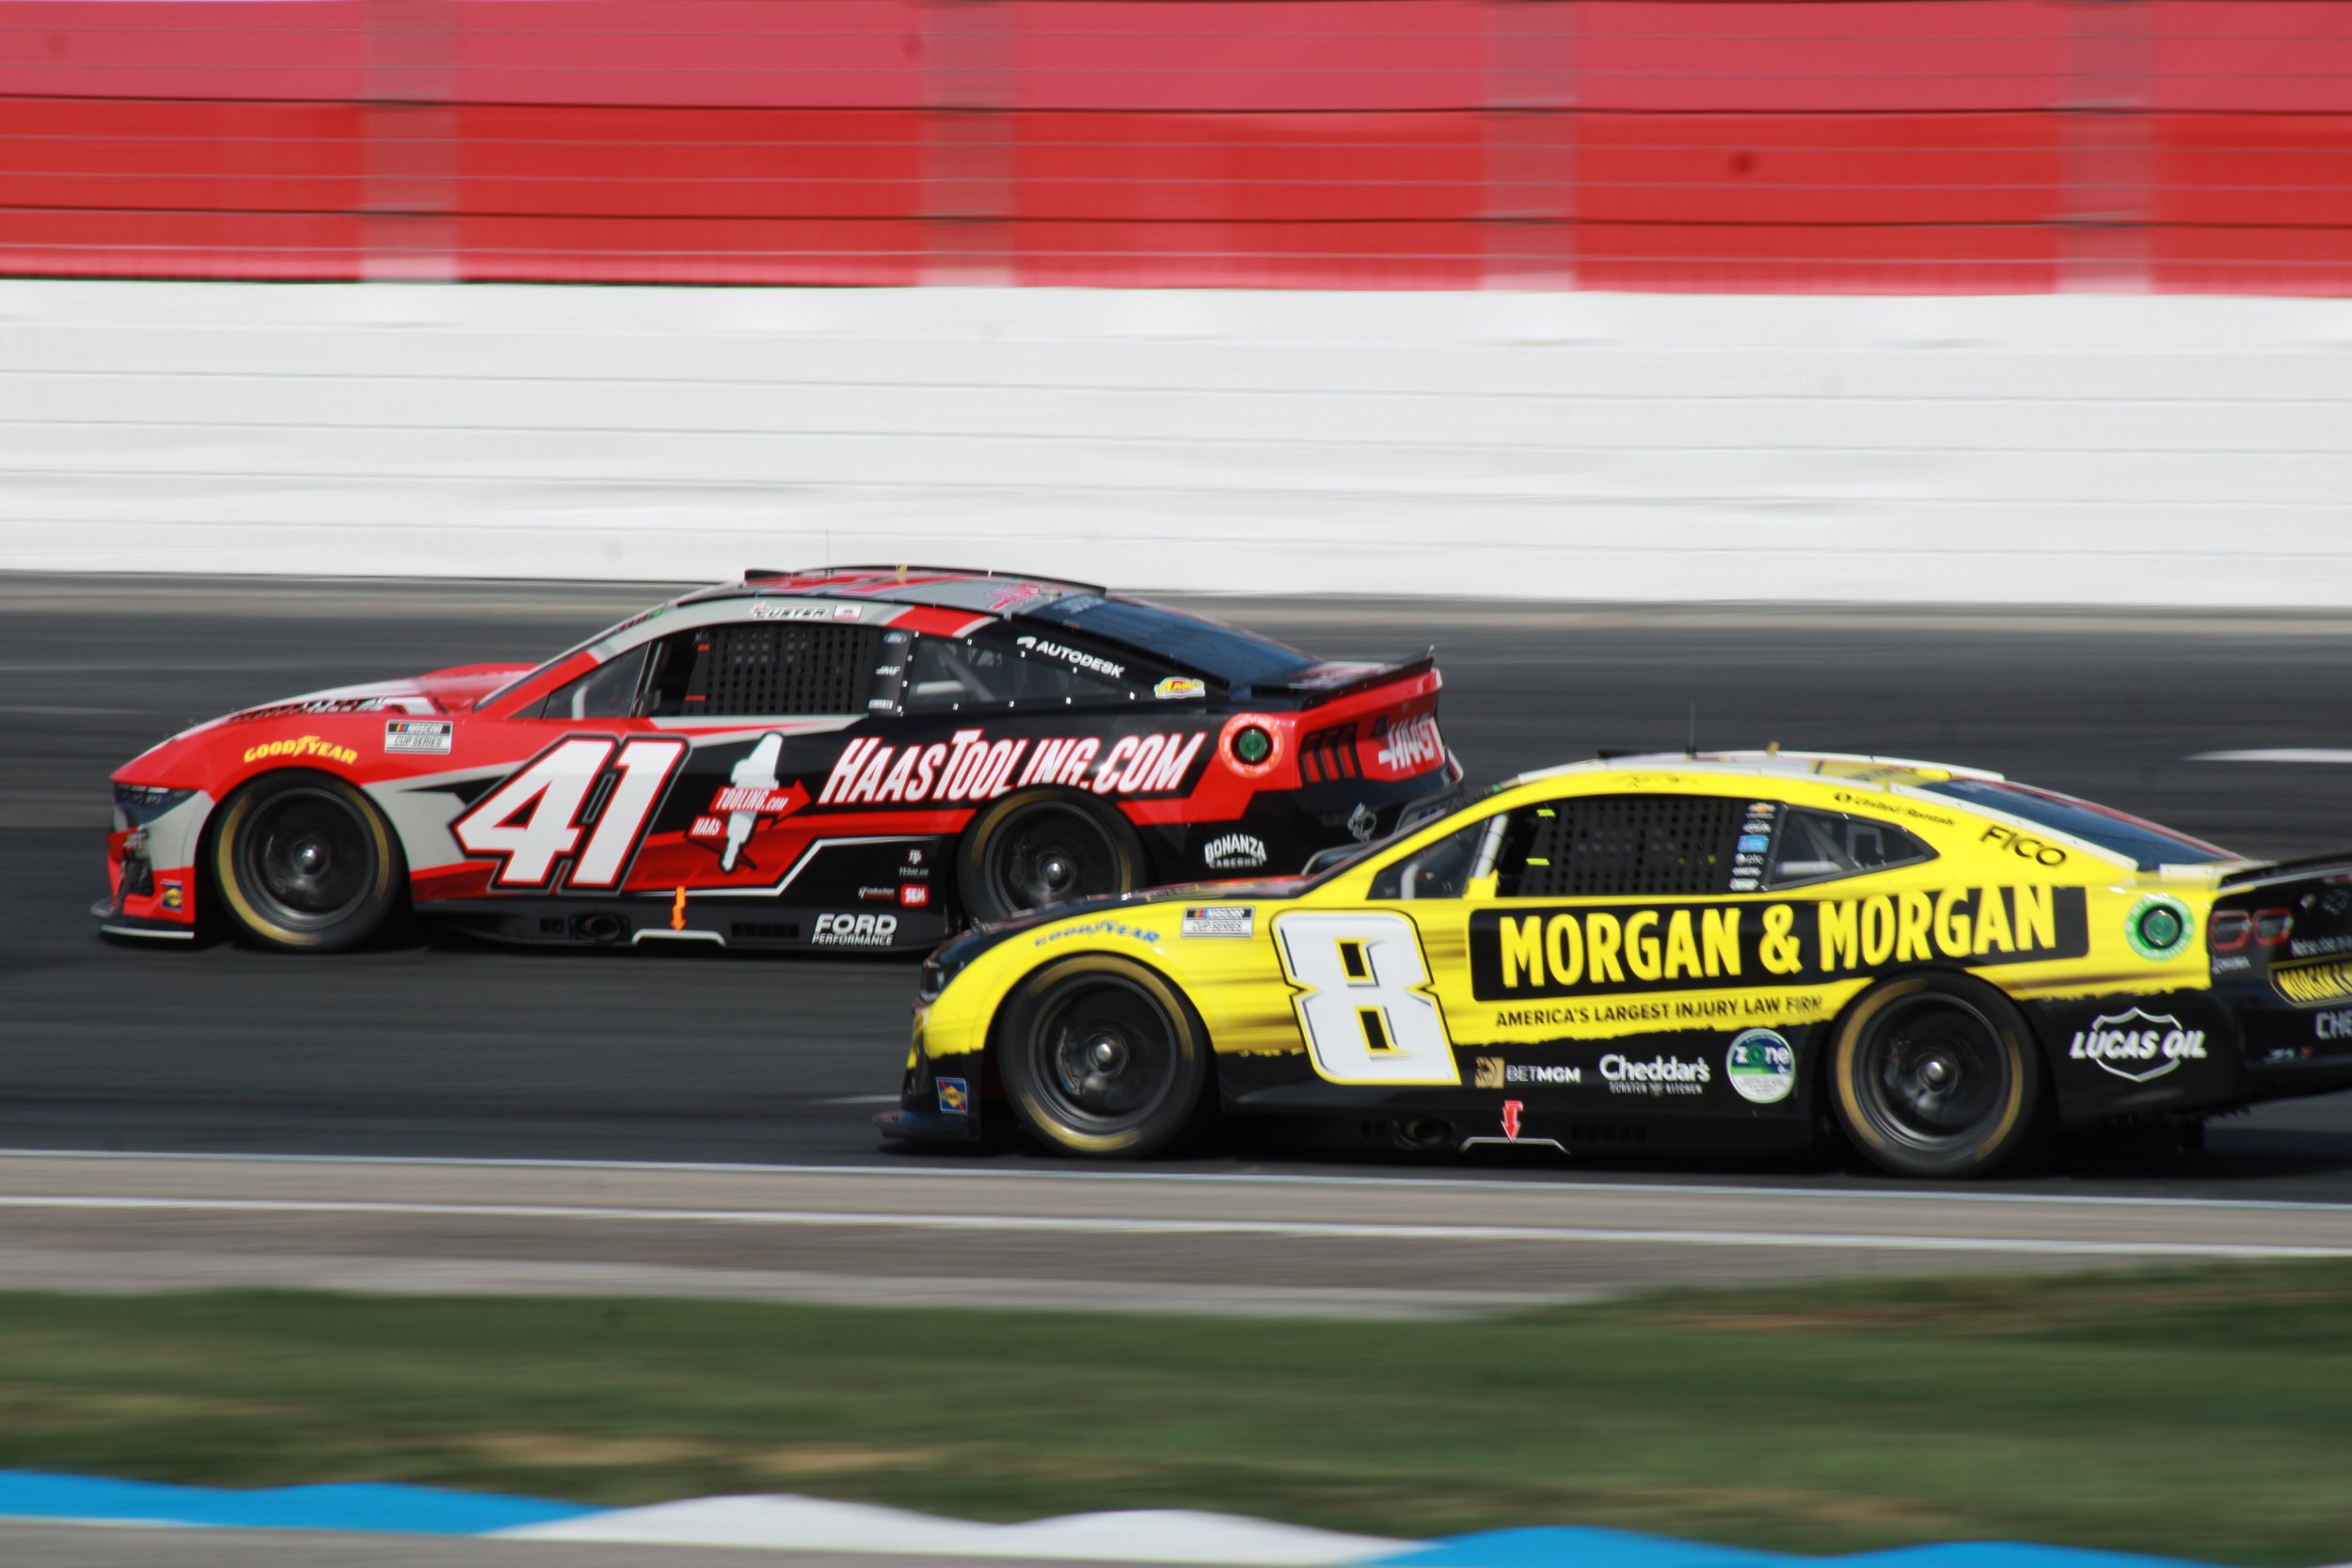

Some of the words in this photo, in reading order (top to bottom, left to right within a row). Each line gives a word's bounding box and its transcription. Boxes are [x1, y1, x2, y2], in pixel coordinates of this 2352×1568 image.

[1036, 641, 1125, 679] AUTODESK
[243, 735, 358, 765] GOODYEAR
[454, 737, 685, 887] 41
[691, 816, 723, 836] HAAS
[1204, 833, 1267, 863] BONANZA
[1979, 825, 2067, 866] FICO
[812, 932, 894, 946] PERFORMANCE
[815, 913, 897, 935] FORD
[1499, 907, 1741, 988] MORGAN
[1758, 904, 1804, 974] &
[1818, 883, 2056, 973] MORGAN
[1270, 910, 1462, 1085] 8
[1496, 1006, 1590, 1028] AMERICA'S
[1594, 1003, 1670, 1023] LARGEST
[1676, 999, 1739, 1020] INJURY
[1744, 996, 1780, 1015] LAW
[1787, 994, 1823, 1014] FIRM
[2070, 1030, 2160, 1059] LUCAS
[2162, 1029, 2208, 1059] OIL
[1506, 1064, 1581, 1084] BETMGM
[1598, 1053, 1711, 1084] Cheddar's
